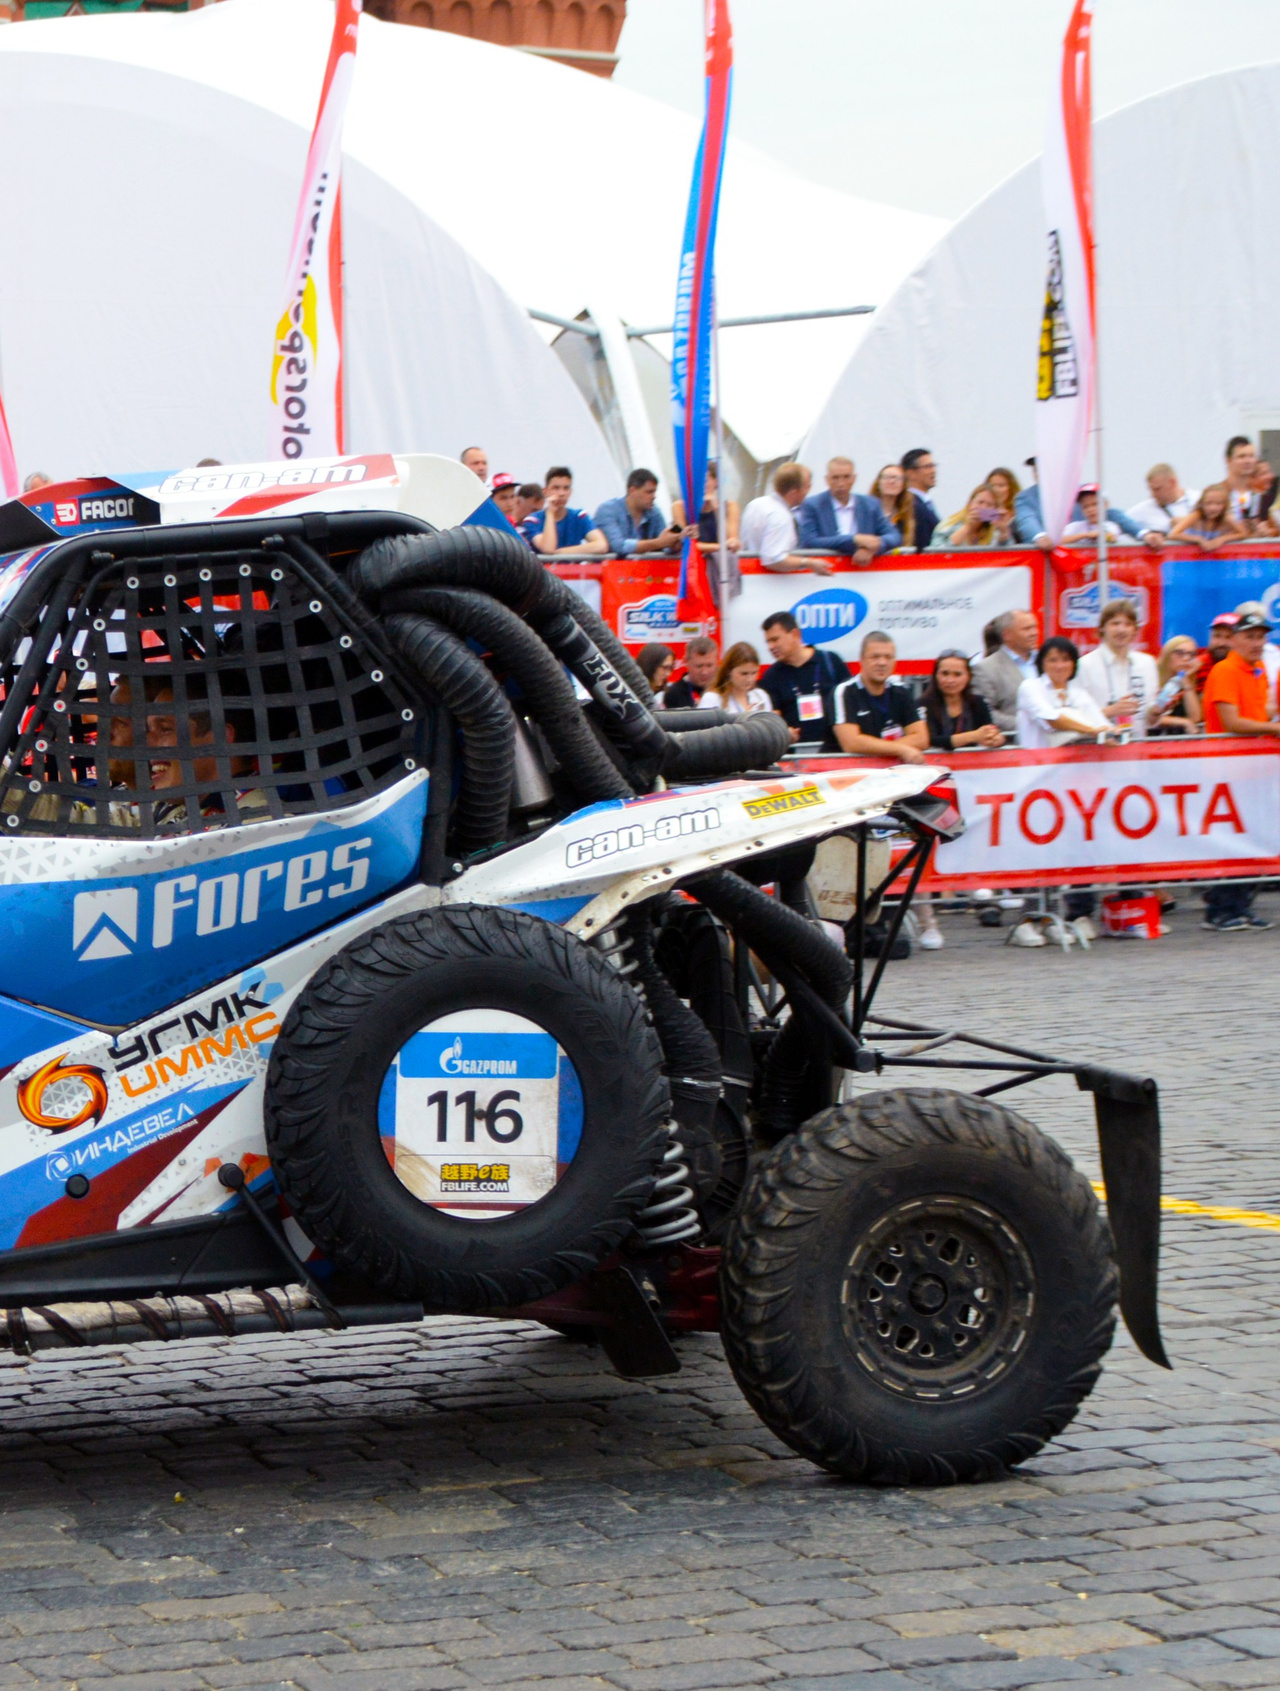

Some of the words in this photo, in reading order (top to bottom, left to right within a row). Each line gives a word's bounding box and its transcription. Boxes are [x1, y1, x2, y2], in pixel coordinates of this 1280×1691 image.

[159, 464, 367, 494] can-am
[795, 602, 856, 629] ОПТИ
[583, 652, 640, 719] FOX
[565, 807, 721, 868] can-am
[975, 782, 1246, 847] TOYOTA
[152, 837, 371, 949] Fores
[107, 980, 271, 1072] УГМК
[120, 1011, 281, 1098] UMMC
[462, 1059, 517, 1075] GAZPROM
[73, 1102, 196, 1165] ИНДЕВЕЛ
[157, 1118, 199, 1140] Development
[427, 1089, 523, 1144] 116
[441, 1163, 510, 1181] 越野e族
[441, 1181, 510, 1192] FBLIFE.COM
